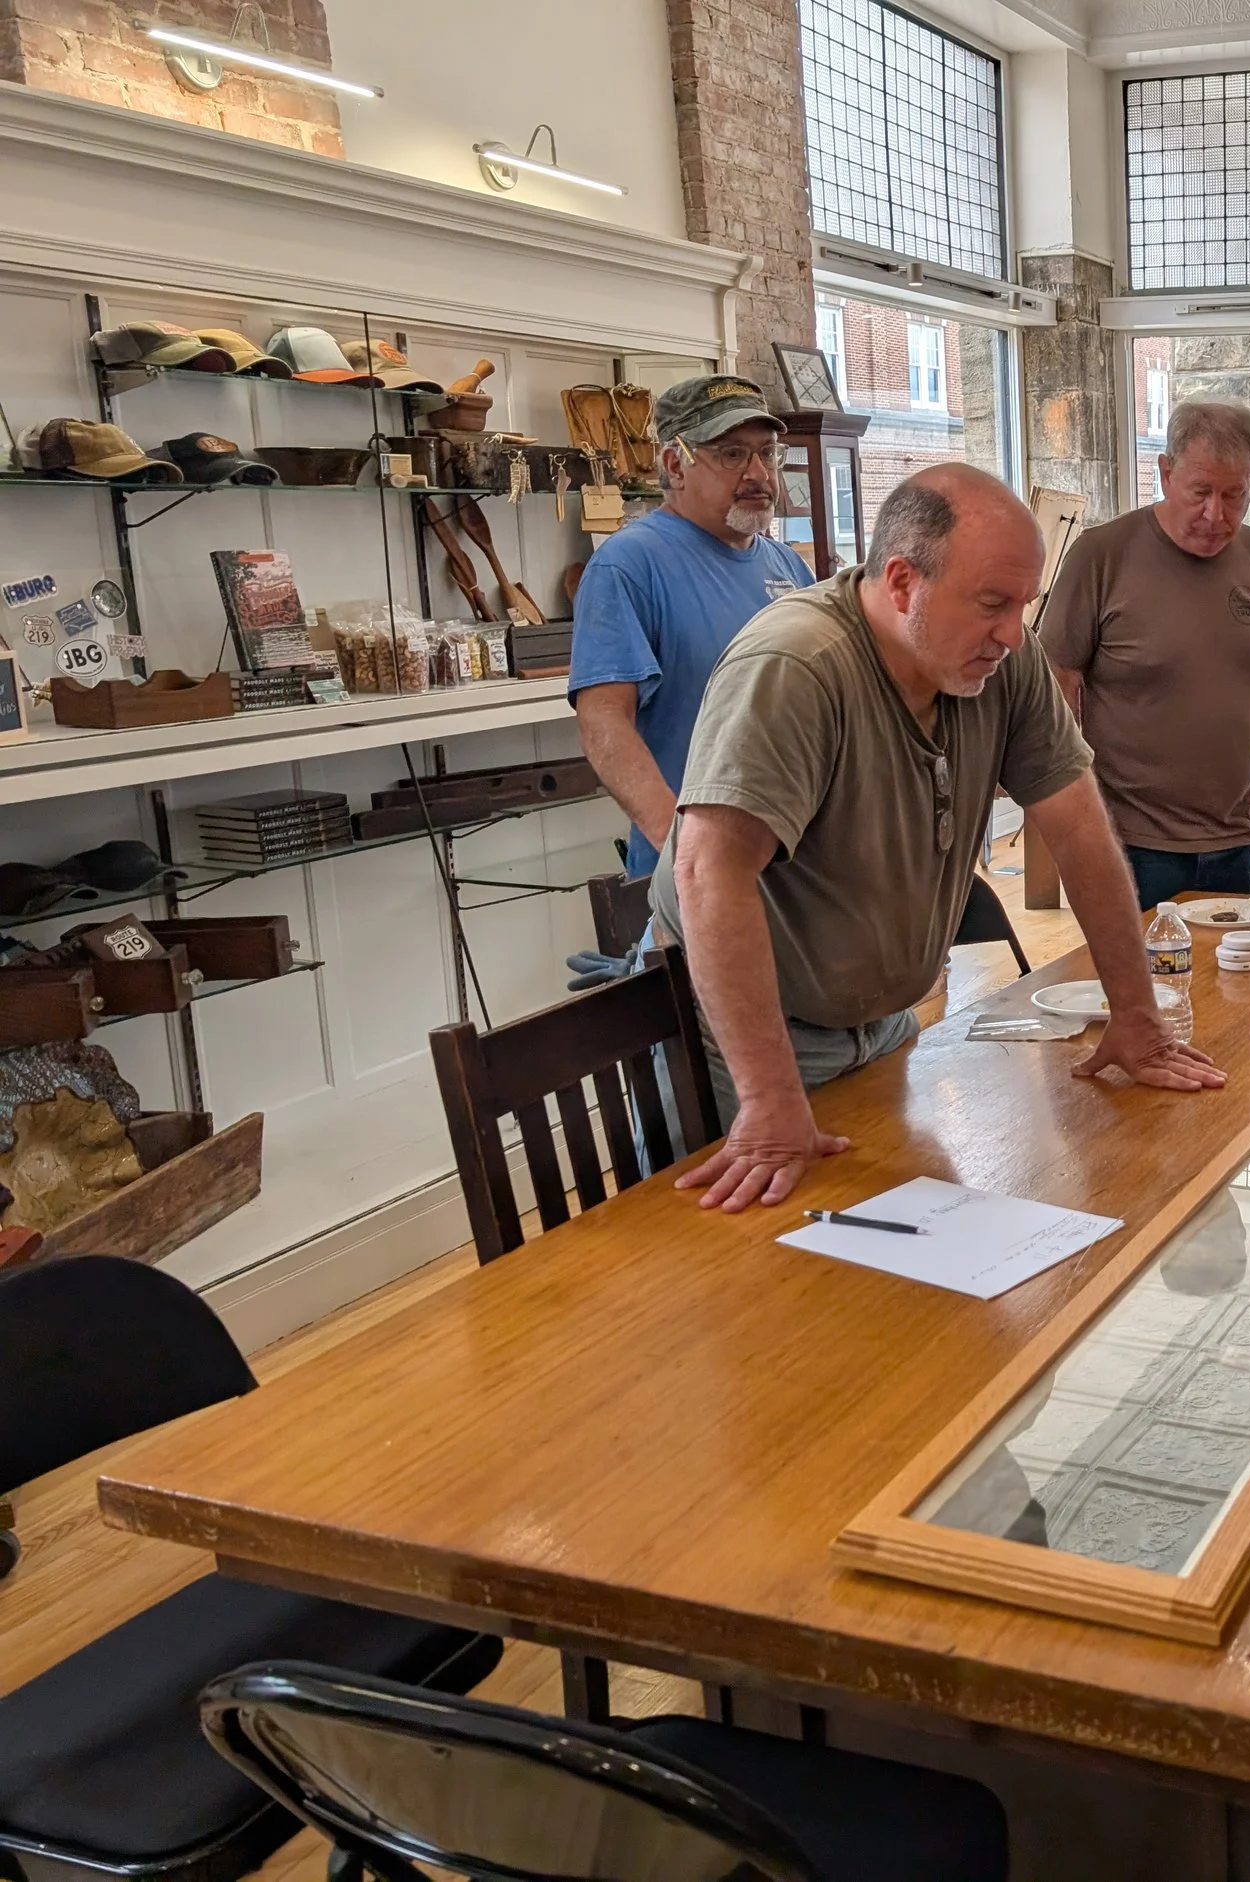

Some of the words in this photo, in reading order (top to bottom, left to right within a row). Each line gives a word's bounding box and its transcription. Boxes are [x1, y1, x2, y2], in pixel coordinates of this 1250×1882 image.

[28, 630, 49, 644] 219
[64, 644, 103, 670] JBG
[110, 928, 134, 942] ROUTE
[117, 937, 145, 957] 219
